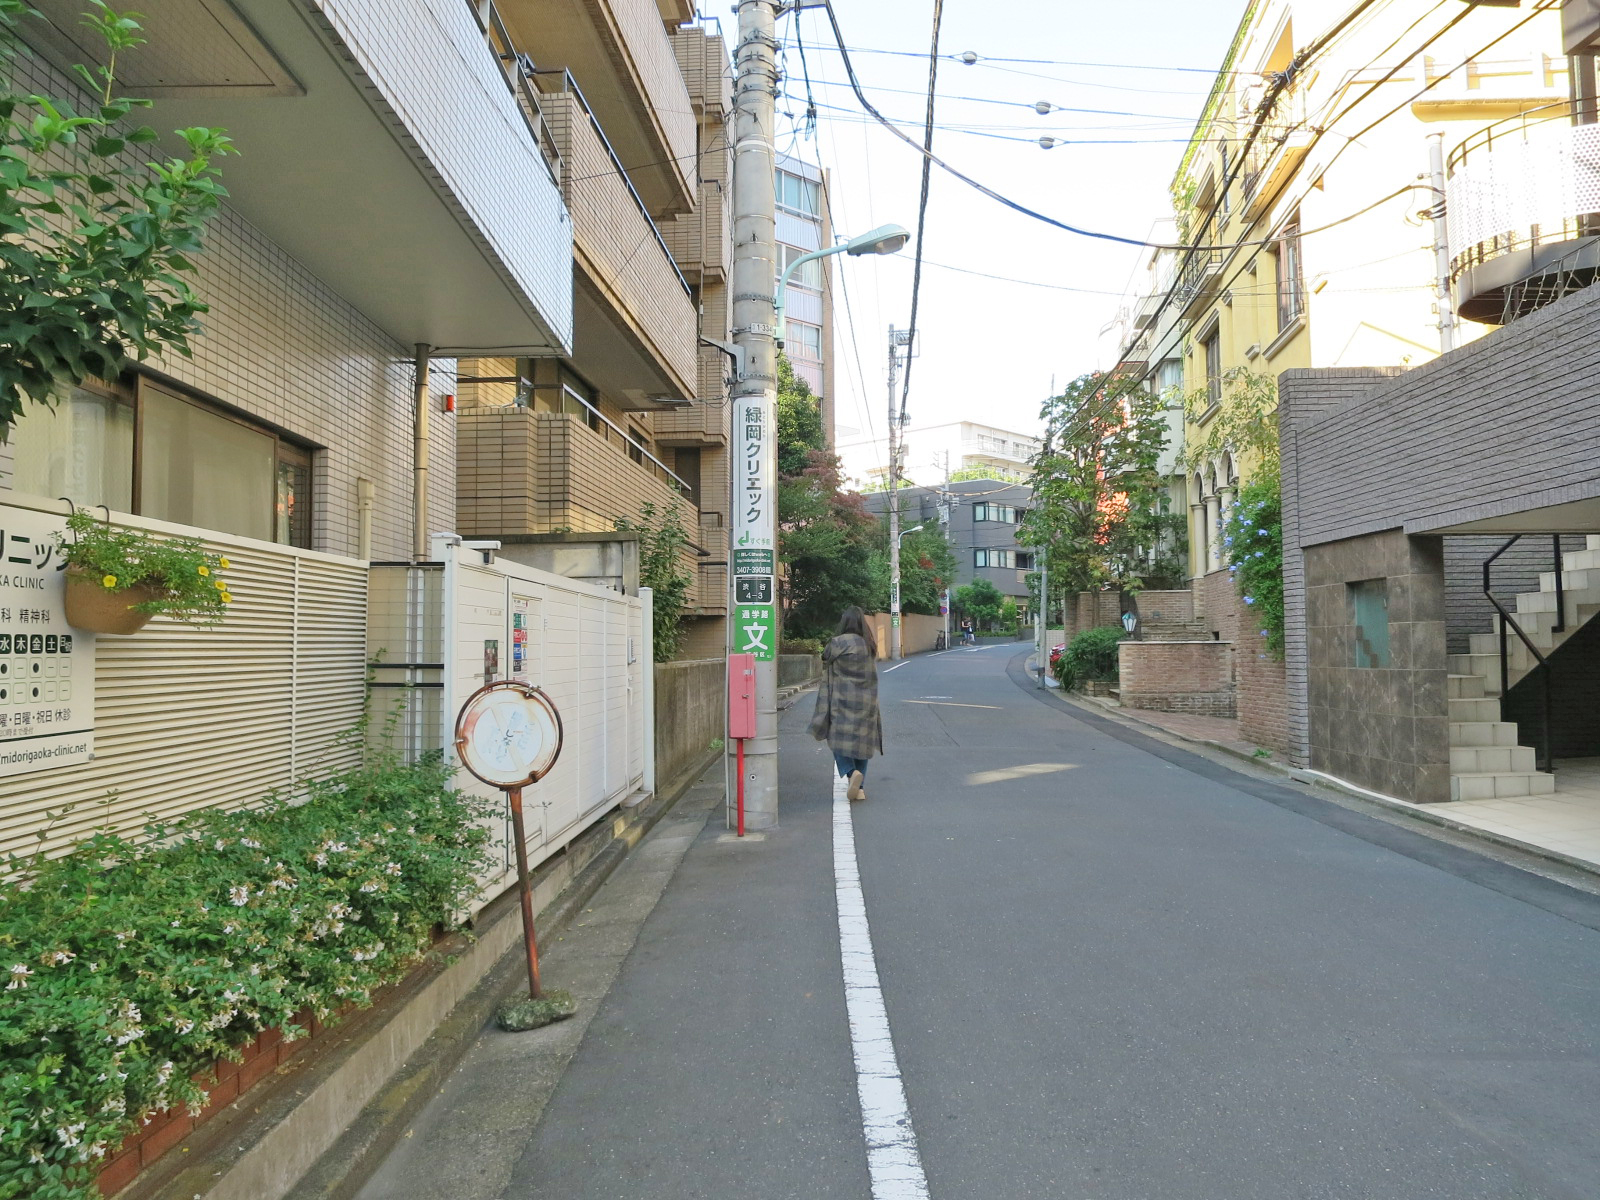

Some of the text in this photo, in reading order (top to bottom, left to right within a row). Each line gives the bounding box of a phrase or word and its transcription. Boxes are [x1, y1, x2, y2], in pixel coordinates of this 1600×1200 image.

[12, 575, 45, 590] CLINIC
[19, 608, 50, 625] 精神科
[741, 609, 769, 619] 通学路
[0, 636, 11, 651] 水
[16, 636, 27, 651] 木
[32, 637, 42, 651] 金
[46, 637, 56, 651] 土
[742, 621, 769, 651] 文
[55, 708, 72, 722] 休診
